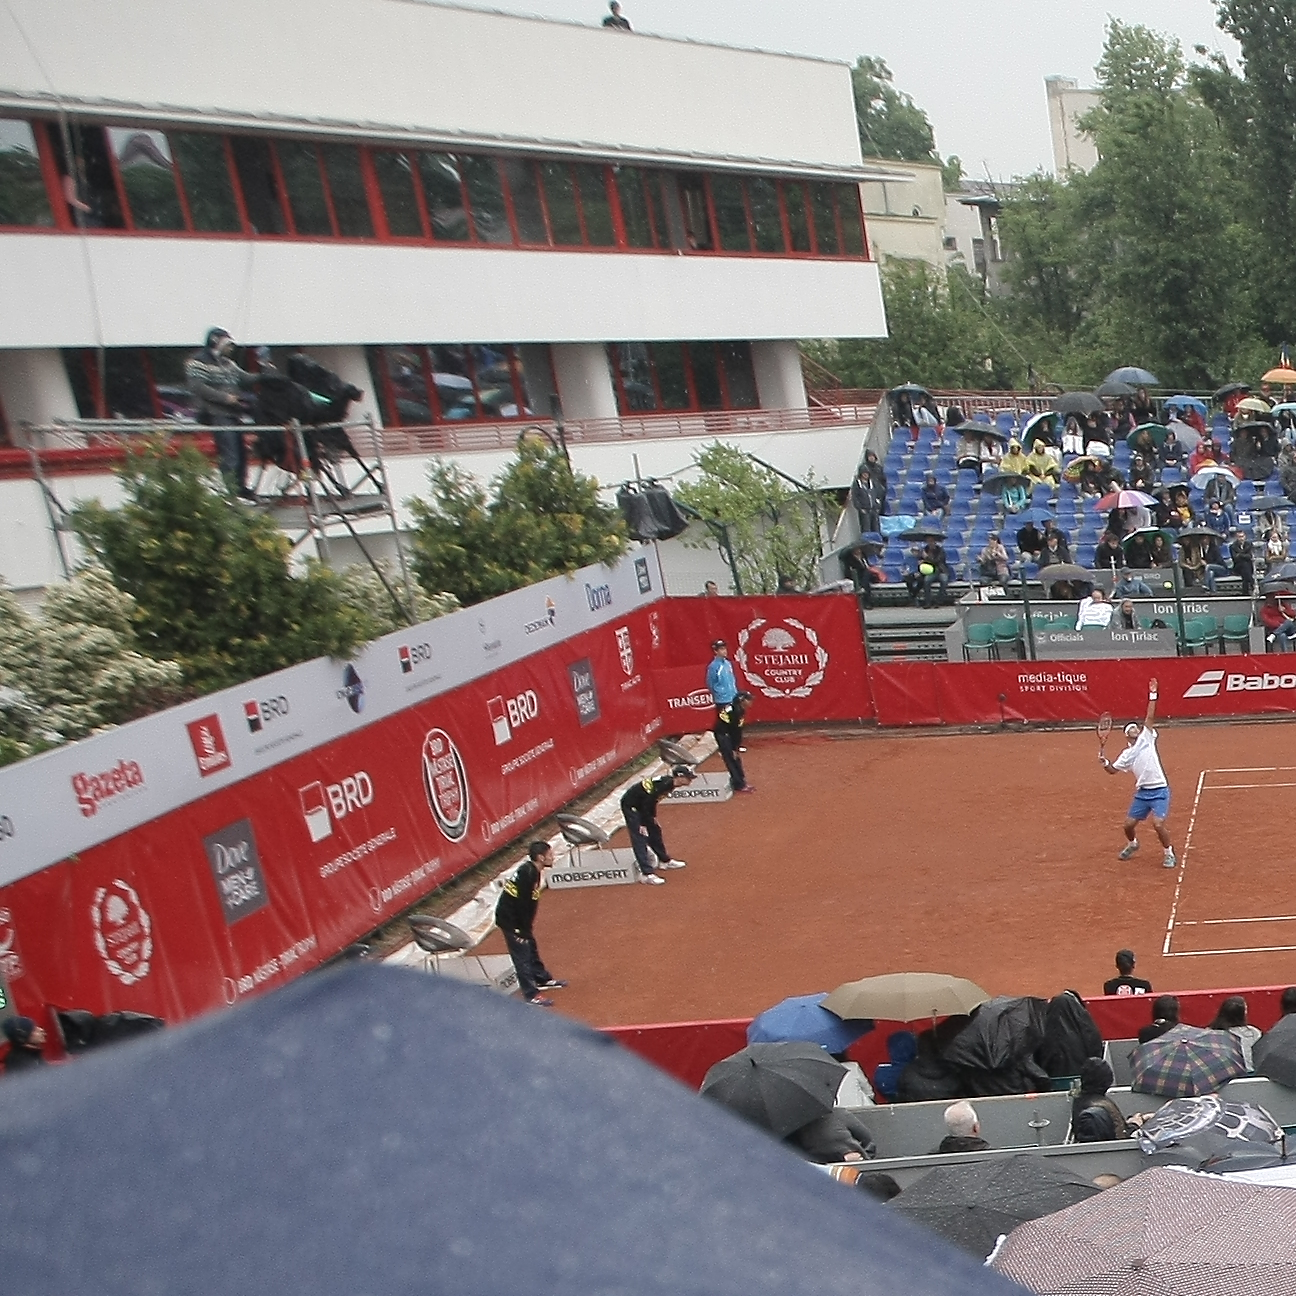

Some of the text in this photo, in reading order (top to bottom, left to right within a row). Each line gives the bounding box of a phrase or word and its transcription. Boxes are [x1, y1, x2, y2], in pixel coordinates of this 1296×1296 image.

[1153, 603, 1173, 615] Ion
[1049, 632, 1084, 642] Officials
[1111, 631, 1128, 641] Ion
[754, 654, 809, 667] STEJARII
[764, 668, 802, 677] COUNTRY
[774, 675, 796, 684] CLUB
[1018, 671, 1087, 686] media-tique
[1019, 684, 1088, 693] SPORT DIVISION
[260, 695, 289, 721] BRD
[507, 689, 538, 728] BRD
[667, 693, 714, 710] TRANSEN
[72, 759, 145, 818] gazeta
[326, 770, 374, 819] BRD
[551, 868, 629, 884] MOBEXPERT
